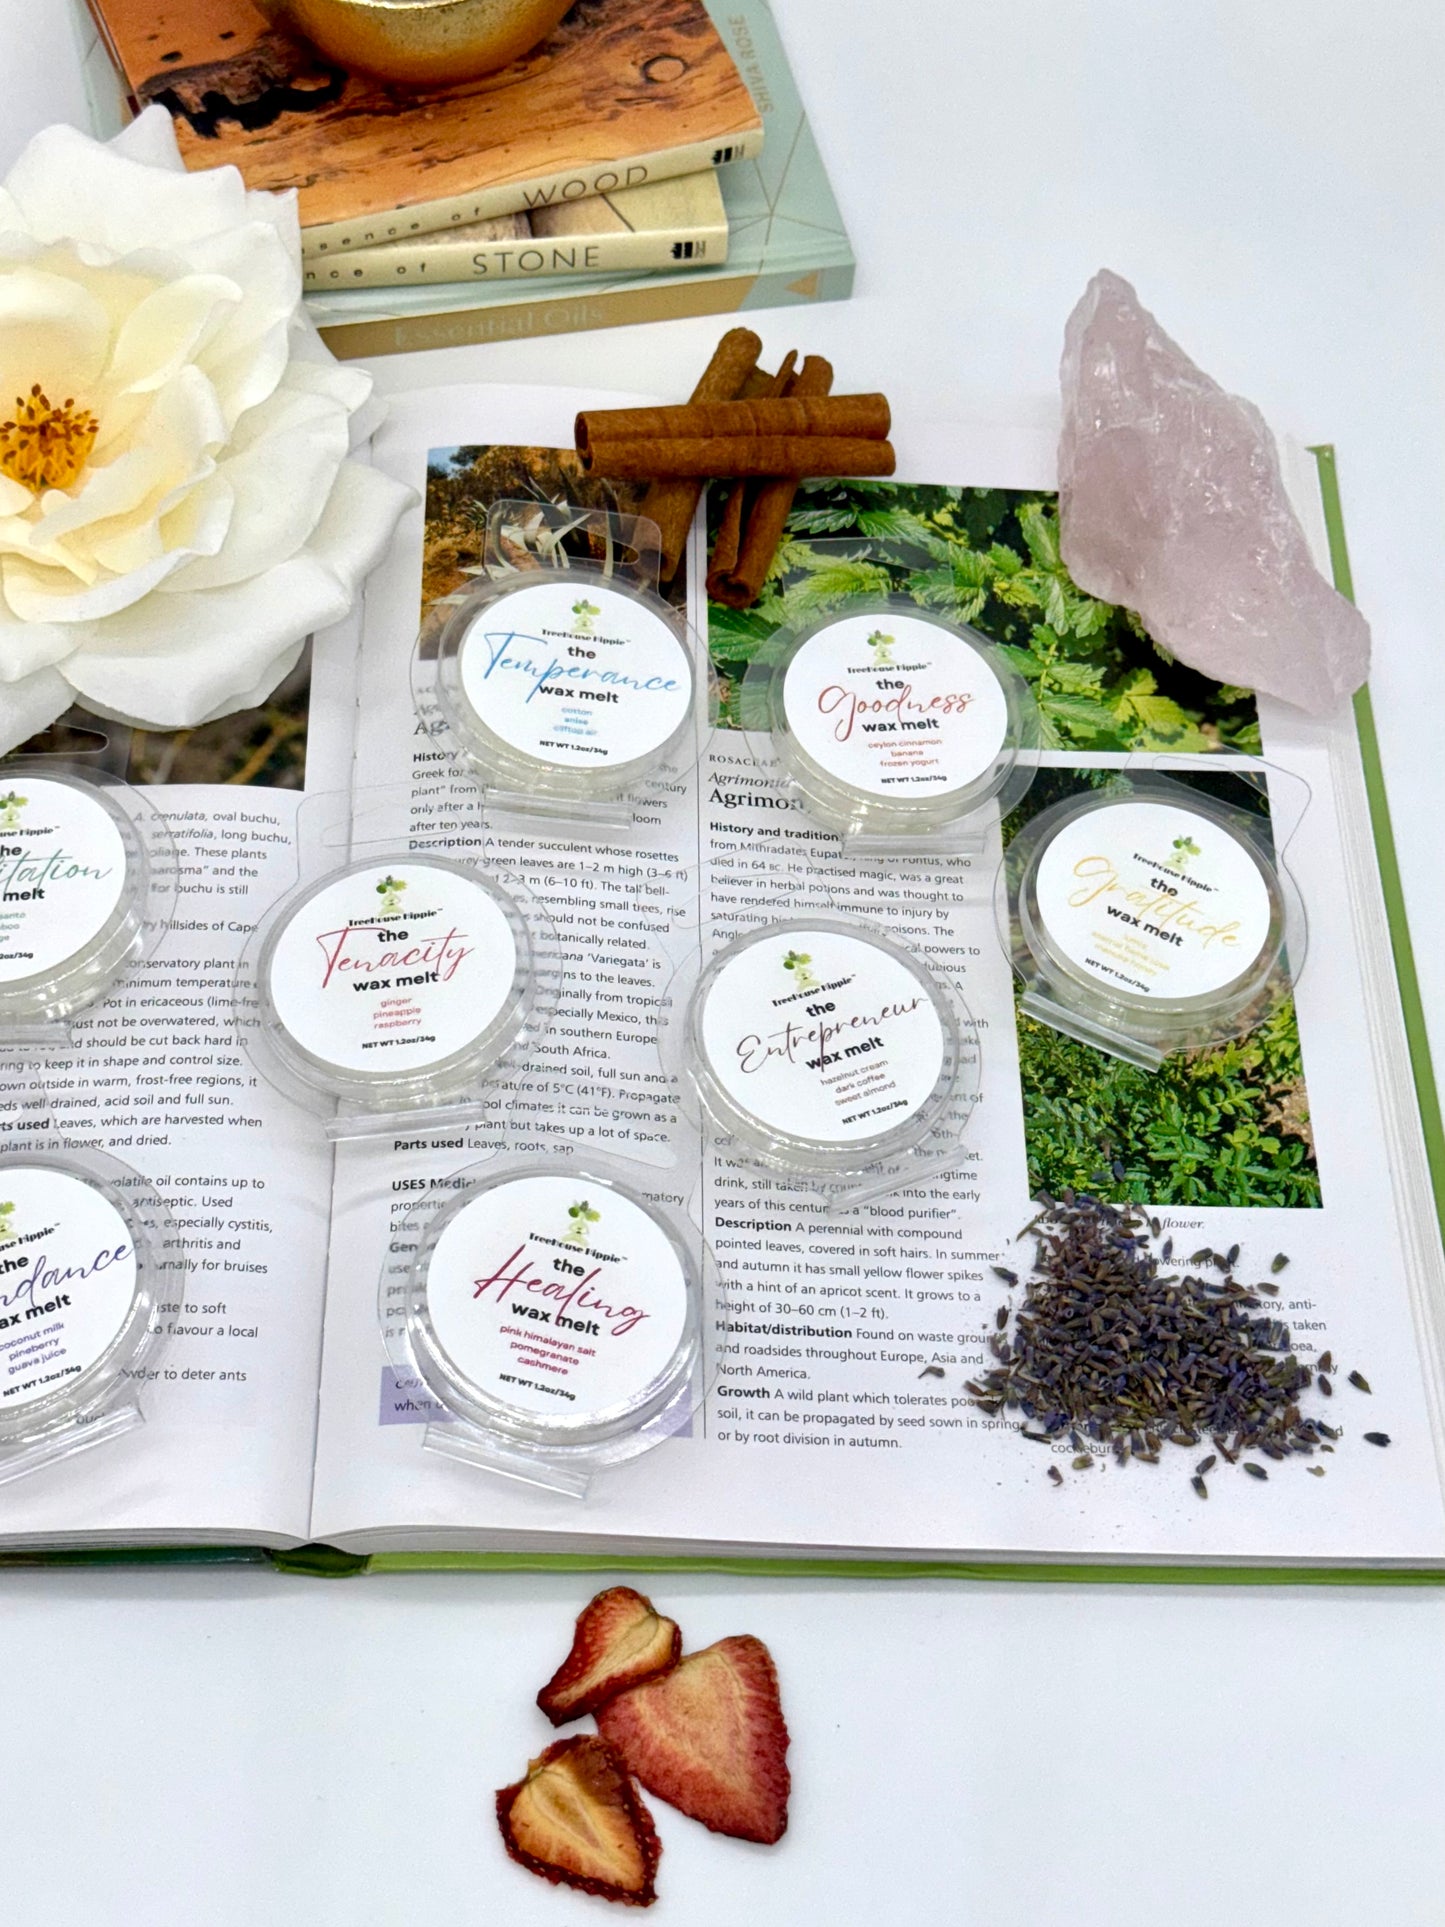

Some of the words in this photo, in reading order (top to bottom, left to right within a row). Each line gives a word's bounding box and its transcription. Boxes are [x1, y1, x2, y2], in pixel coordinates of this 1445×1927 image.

[451, 207, 480, 221] of
[522, 165, 649, 210] WOOD
[397, 262, 426, 275] of
[473, 246, 600, 275] STONE
[394, 310, 533, 348] Essential
[544, 303, 603, 326] Oils
[567, 646, 596, 659] the
[484, 632, 682, 704] Temperance
[539, 684, 574, 697] wax
[579, 689, 619, 704] melt
[876, 678, 904, 690] the
[862, 722, 897, 732] wax
[901, 718, 940, 731] melt
[898, 738, 943, 747] cinnamon
[880, 759, 909, 767] frozen
[911, 758, 940, 767] yogurt
[890, 749, 924, 757] banana
[212, 811, 238, 823] oval
[240, 811, 280, 826] buchu,
[221, 829, 247, 842] long
[250, 830, 292, 845] buchu,
[710, 822, 754, 837] History
[757, 825, 780, 838] and
[784, 828, 839, 842] tradition
[409, 837, 482, 851] Description
[485, 838, 494, 848] A
[497, 838, 534, 850] tender
[537, 839, 591, 853] succulent
[595, 844, 631, 857] whose
[635, 849, 679, 863] rosettes
[2, 888, 45, 902] melt
[1150, 877, 1178, 897] the
[377, 929, 409, 943] the
[1107, 905, 1142, 927] wax
[1143, 923, 1184, 947] melt
[316, 927, 475, 989] Tenacity
[1085, 957, 1101, 968] NET
[1101, 963, 1114, 975] WT
[352, 978, 391, 993] wax
[396, 971, 440, 987] melt
[373, 1006, 422, 1020] pineapple
[380, 997, 412, 1009] ginger
[805, 1000, 836, 1018] the
[374, 1017, 422, 1031] raspberry
[361, 1041, 379, 1050] NET
[379, 1040, 394, 1048] WT
[736, 997, 929, 1074] Entrepreneur
[44, 1057, 73, 1073] keep
[76, 1057, 84, 1069] it
[88, 1056, 99, 1068] in
[103, 1053, 139, 1070] shape
[143, 1053, 166, 1067] and
[169, 1052, 214, 1067] control
[217, 1054, 243, 1067] size.
[805, 1052, 843, 1070] wax
[845, 1035, 885, 1059] melt
[820, 1068, 859, 1087] hazelnut
[860, 1059, 889, 1074] cream
[835, 1081, 856, 1094] dark
[856, 1072, 886, 1088] coffee
[835, 1092, 864, 1107] sweet
[866, 1080, 896, 1098] almond
[842, 1113, 858, 1125] NET
[858, 1109, 872, 1120] WT
[394, 1139, 429, 1150] Parts
[431, 1138, 464, 1150] used
[467, 1138, 510, 1151] Leaves,
[174, 1175, 228, 1188] contains
[231, 1177, 247, 1191] up
[251, 1178, 265, 1190] to
[715, 1217, 792, 1233] Description
[795, 1222, 805, 1232] A
[808, 1222, 864, 1237] perennial
[866, 1226, 894, 1238] with
[897, 1227, 963, 1242] compound
[1163, 1216, 1205, 1230] flower.
[162, 1237, 214, 1251] arthritis
[217, 1238, 240, 1251] and
[0, 1255, 29, 1275] the
[552, 1257, 586, 1277] the
[473, 1243, 651, 1337] Healing
[25, 1294, 72, 1320] melt
[511, 1302, 551, 1323] wax
[555, 1315, 600, 1337] melt
[0, 1331, 42, 1351] coconut
[43, 1321, 65, 1336] milk
[499, 1325, 522, 1338] pink
[523, 1328, 575, 1352] himalayan
[576, 1344, 596, 1357] salt
[9, 1337, 60, 1361] pineberry
[510, 1341, 579, 1365] pomegranate
[8, 1357, 40, 1375] guava
[41, 1347, 67, 1365] juice
[517, 1356, 569, 1375] cashmere
[499, 1374, 517, 1384] NET
[517, 1378, 532, 1388] WT
[717, 1363, 753, 1378] North
[756, 1366, 811, 1380] America.
[2, 1385, 21, 1397] NET
[21, 1379, 37, 1390] WT
[717, 1385, 770, 1400] Growth
[774, 1388, 784, 1400] A
[787, 1388, 813, 1402] wild
[817, 1391, 849, 1406] plant
[852, 1392, 890, 1406] which
[894, 1394, 947, 1407] tolerates
